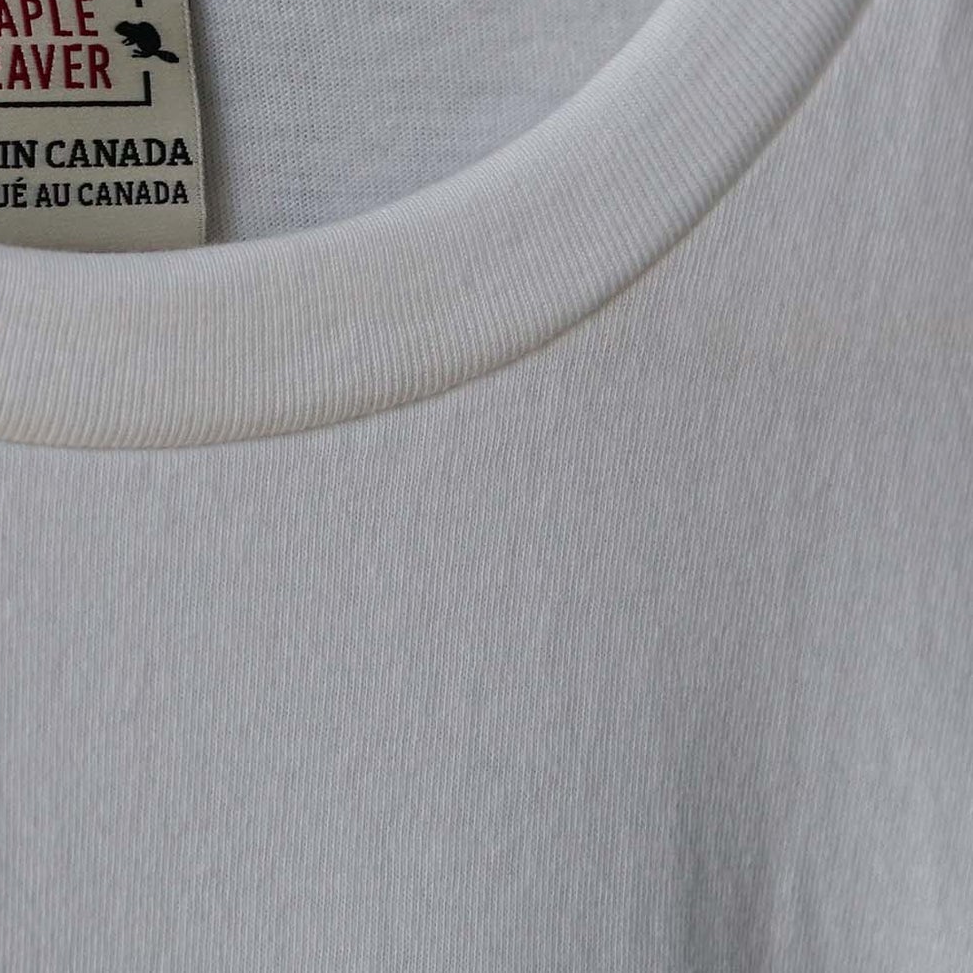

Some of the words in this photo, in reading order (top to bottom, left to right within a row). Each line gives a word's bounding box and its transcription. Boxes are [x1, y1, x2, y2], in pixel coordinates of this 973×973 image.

[45, 138, 193, 168] CANADA
[34, 183, 71, 207] AU
[78, 180, 190, 206] CANADA
